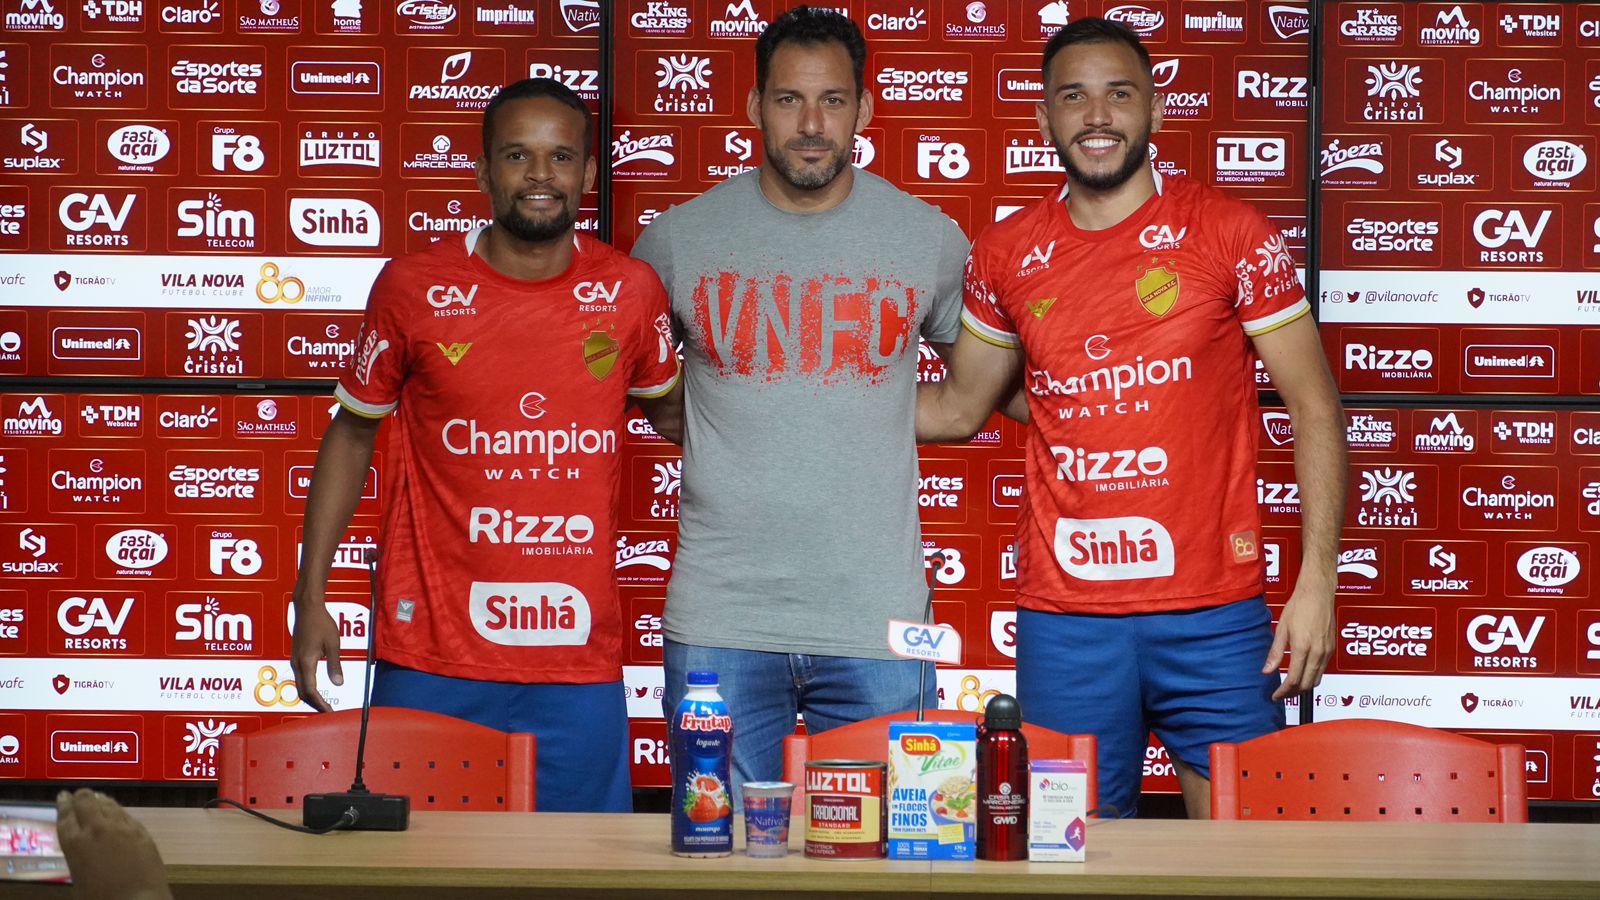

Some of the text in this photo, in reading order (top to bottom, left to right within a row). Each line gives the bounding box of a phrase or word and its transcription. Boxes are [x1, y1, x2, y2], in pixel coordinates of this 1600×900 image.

[106, 0, 142, 16] TDH
[162, 7, 210, 24] Claro
[477, 5, 534, 25] Imprilux
[647, 2, 688, 17] KING
[6, 11, 64, 29] moving
[240, 16, 298, 26] SÃO MATHEUS
[631, 12, 688, 28] GRASS
[868, 9, 915, 30] Claro
[1185, 12, 1243, 33] Imprilux
[1356, 10, 1397, 26] KING
[1519, 15, 1560, 30] TDH
[946, 24, 1005, 34] SÃO MATHEUS
[1340, 20, 1397, 36] GRASS
[1421, 27, 1479, 44] moving
[171, 60, 262, 79] Esportes
[877, 68, 968, 86] Esportes
[53, 66, 143, 90] Champion
[301, 72, 353, 84] Unimed
[1469, 81, 1560, 105] Champion
[654, 98, 714, 112] Cristal
[1364, 107, 1423, 120] Cristal
[214, 127, 234, 136] Grupo
[212, 135, 264, 171] F8
[304, 143, 375, 161] LUZTOL
[1218, 142, 1278, 162] TLC
[4, 156, 60, 170] suplax
[918, 142, 970, 179] F8
[1418, 173, 1474, 186] suplax
[59, 193, 136, 231] GAV
[177, 200, 255, 237] Sim
[302, 208, 368, 235] Sinhá
[1347, 218, 1438, 238] Esportes
[1473, 209, 1552, 248] GAV
[67, 234, 128, 245] RESORTS
[207, 239, 254, 247] TELECOM
[1481, 251, 1543, 262] RESORTS
[161, 274, 244, 288] VILA NOVA
[305, 294, 342, 302] INFINITO
[426, 284, 478, 308] GAV
[573, 280, 622, 304] GAV
[1365, 290, 1438, 304] @vilanovafc
[433, 308, 476, 317] RESORTS
[578, 304, 616, 312] RESORTS
[697, 272, 908, 373] VNFC
[62, 338, 112, 349] Unimed
[1346, 344, 1432, 370] Rizzo
[1475, 356, 1525, 366] Unimed
[184, 360, 243, 374] Cristal
[100, 406, 140, 420] TDH
[1059, 401, 1150, 419] WATCH
[4, 415, 62, 434] moving
[160, 409, 208, 428] Claro
[238, 420, 296, 432] SÃO MATHEUS
[1352, 416, 1392, 432] KING
[1513, 422, 1553, 438] TDH
[442, 419, 616, 464] Champion
[1416, 432, 1474, 450] moving
[1050, 446, 1168, 482] Rizzo
[169, 465, 260, 484] Esportes
[485, 468, 580, 480] WATCH
[52, 471, 141, 495] Champion
[1096, 478, 1170, 492] IMOBILIÁRIA
[1463, 487, 1554, 512] Champion
[470, 507, 594, 544] Rizzo
[1358, 512, 1418, 526] Cristal
[212, 531, 232, 540] Grupo
[522, 546, 594, 556] IMOBILIÁRIA
[1069, 528, 1158, 566] Sinhá
[210, 539, 262, 575] F8
[2, 560, 58, 574] suplax
[1412, 578, 1468, 592] suplax
[57, 597, 134, 635] GAV
[486, 596, 576, 630] Sinhá
[176, 604, 252, 640] Sim
[903, 626, 945, 649] GAV
[1341, 622, 1432, 642] Esportes
[1467, 615, 1545, 653] GAV
[65, 638, 126, 649] RESORTS
[906, 648, 941, 658] RESORTS
[1475, 656, 1536, 668] RESORTS
[160, 677, 242, 692] VILA NOVA
[1359, 695, 1432, 708] @vilanovafc
[682, 714, 730, 732] Frutap
[60, 741, 112, 753] Unimed
[906, 738, 936, 752] Sinhá
[806, 770, 870, 793] LUZTOL
[892, 788, 927, 801] AVEIA
[812, 804, 859, 821] TRADICIONAL
[899, 803, 927, 812] FLOCOS
[892, 813, 927, 826] FINOS
